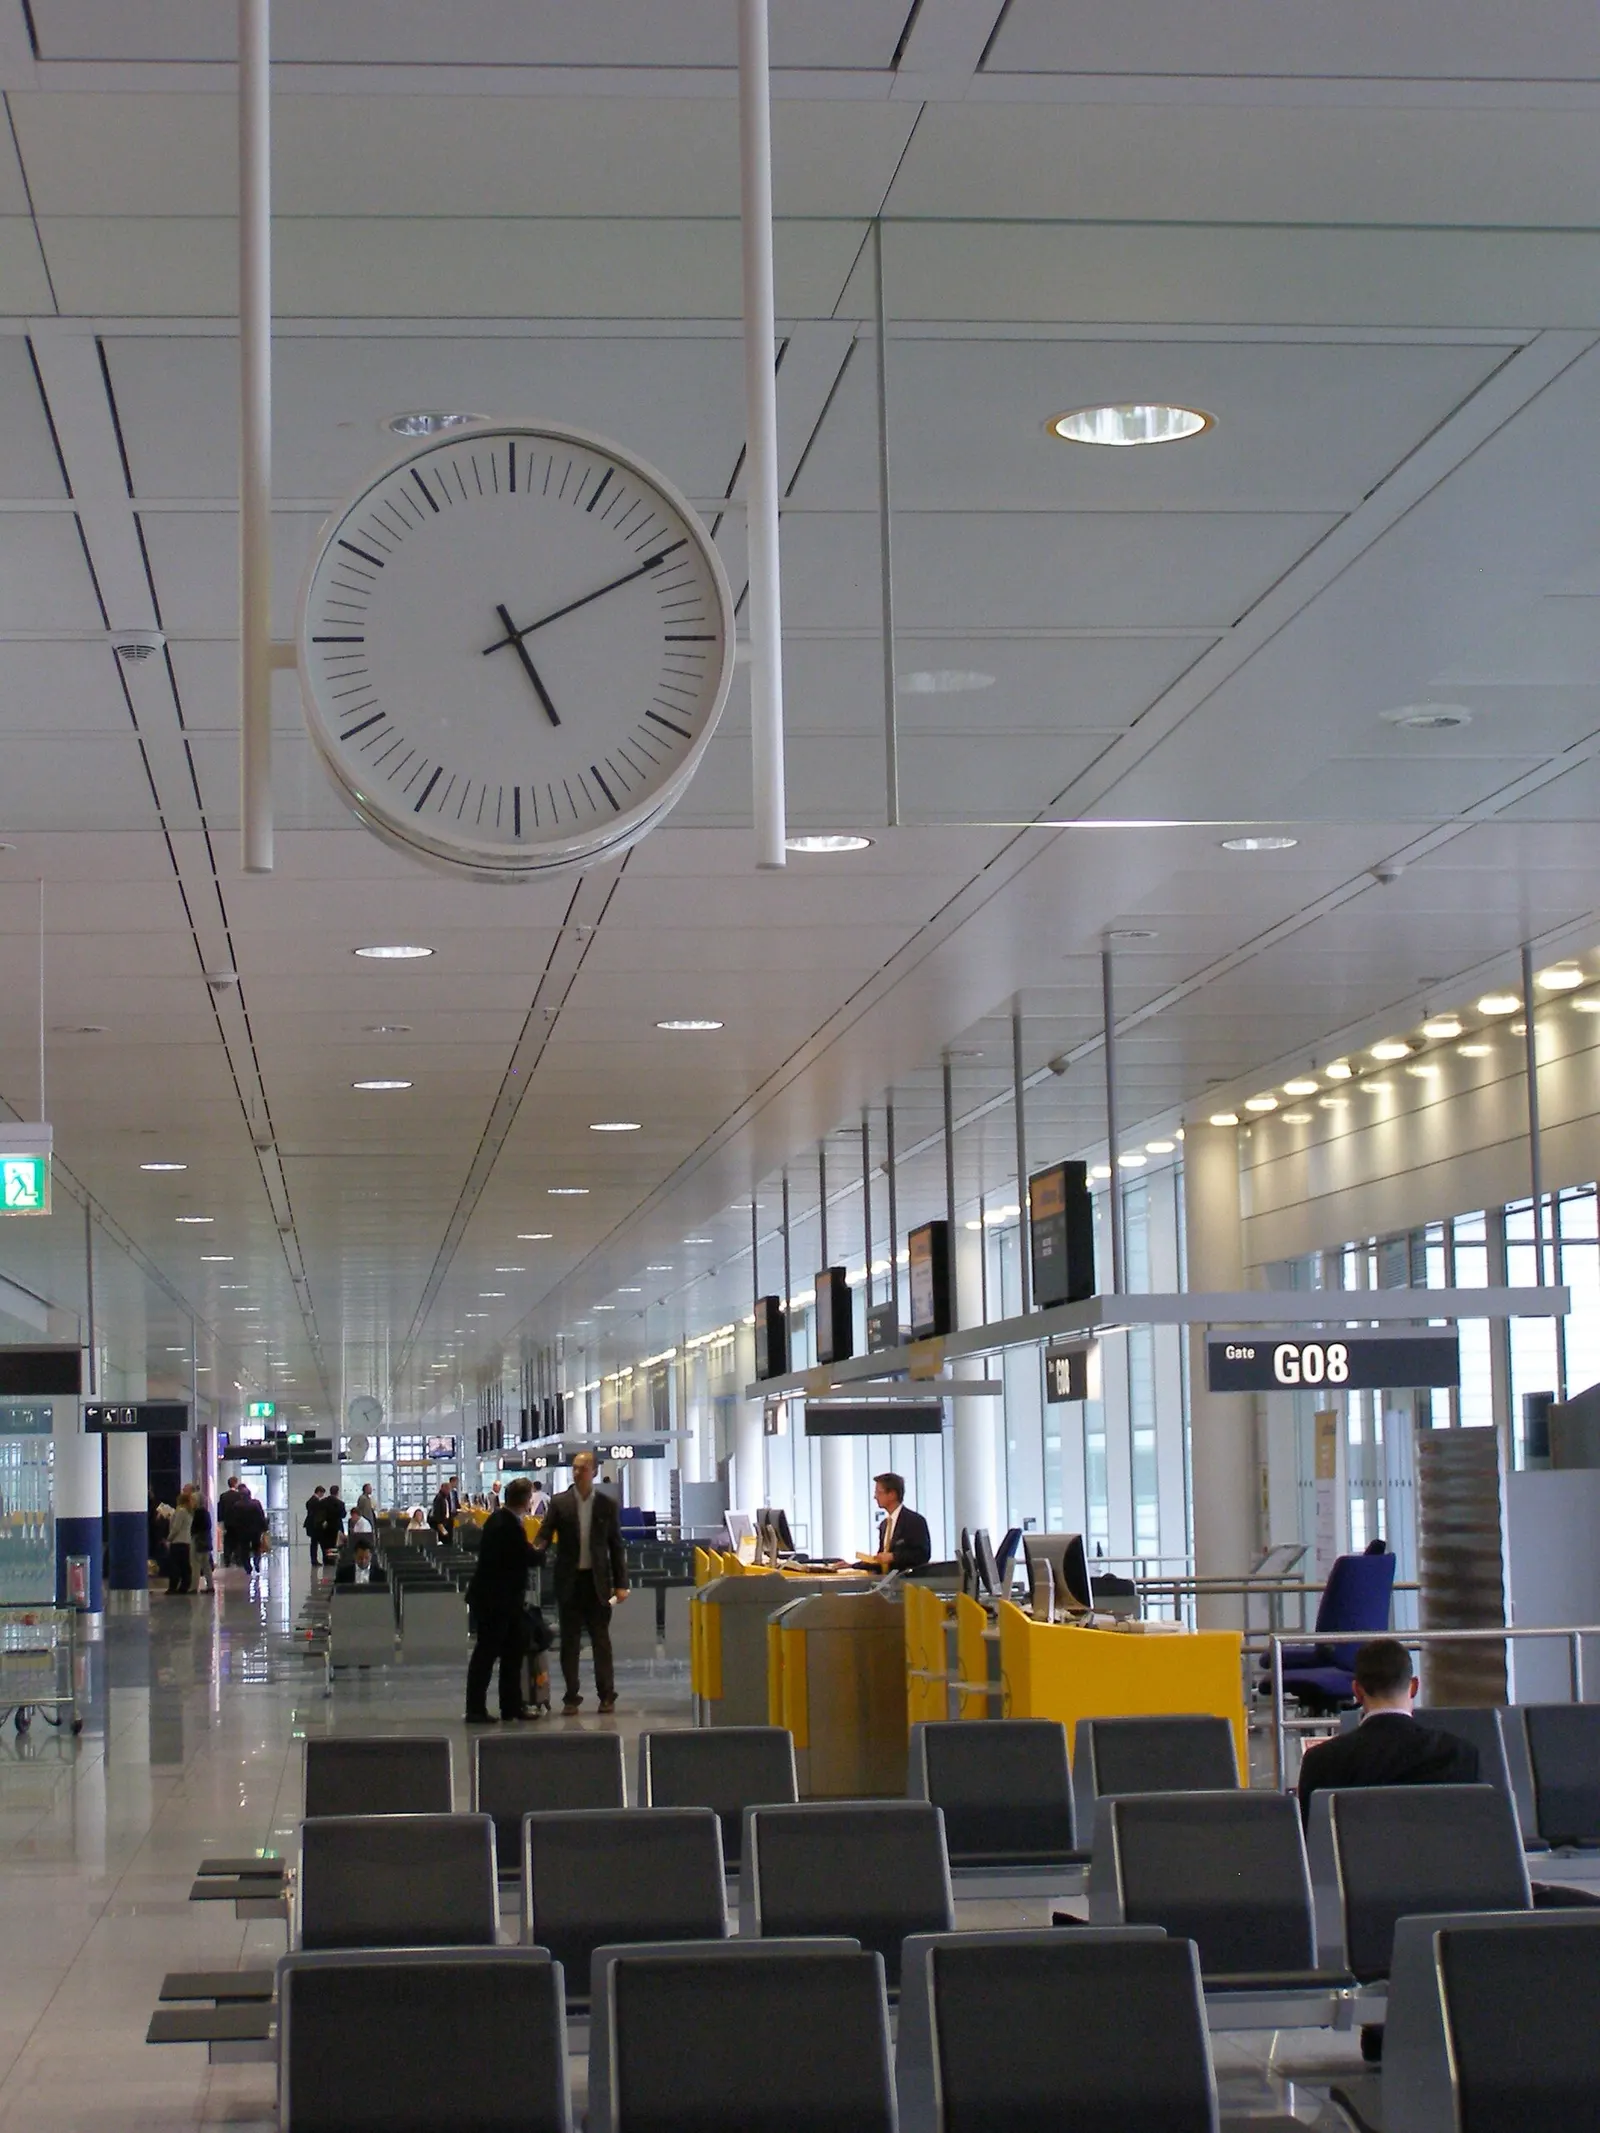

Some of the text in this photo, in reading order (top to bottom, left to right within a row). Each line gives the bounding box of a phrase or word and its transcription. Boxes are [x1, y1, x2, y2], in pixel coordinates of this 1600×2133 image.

[1225, 1343, 1349, 1384] Gate G08
[610, 1445, 634, 1459] G06
[535, 1457, 547, 1467] G0
